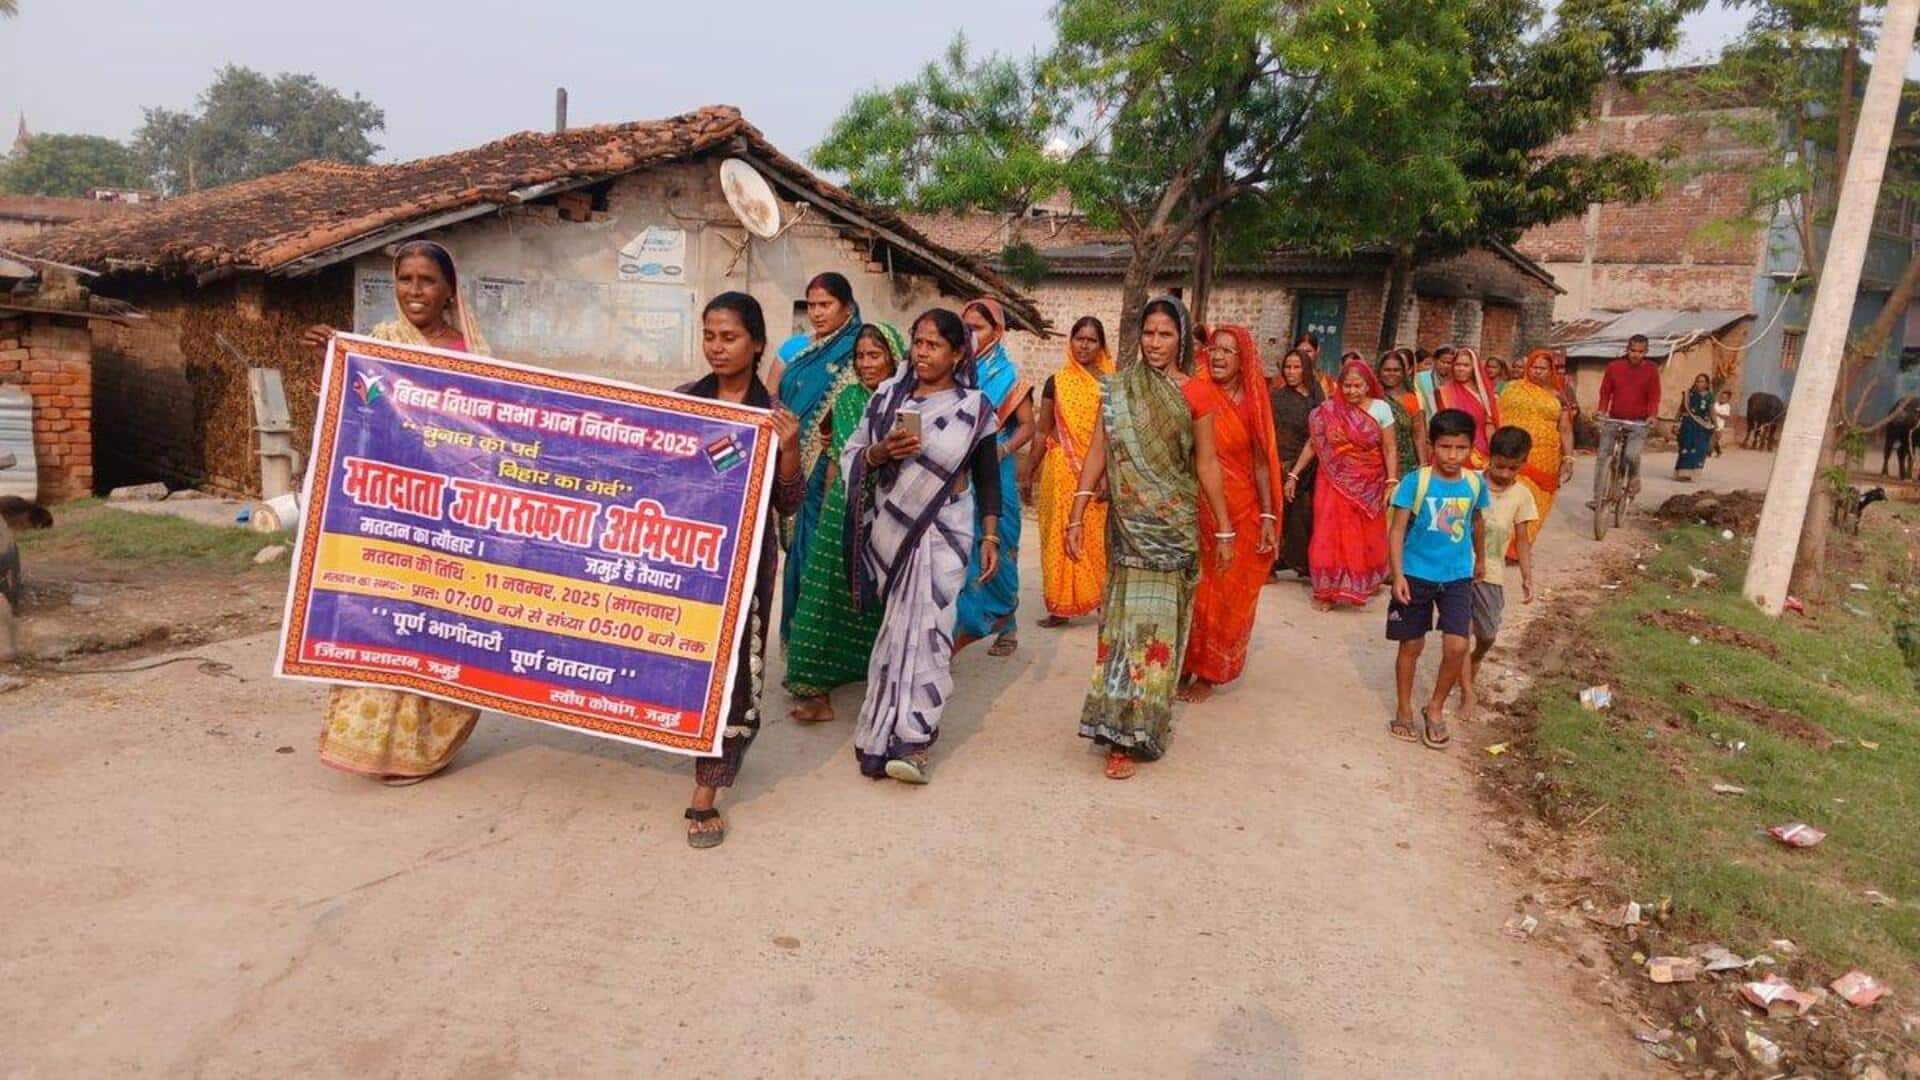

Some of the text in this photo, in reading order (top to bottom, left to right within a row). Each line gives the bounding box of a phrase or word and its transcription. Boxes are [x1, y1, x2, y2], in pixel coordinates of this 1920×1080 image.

[391, 377, 440, 409] बिहार
[442, 388, 493, 419] विधान
[497, 402, 537, 427] सभा
[539, 411, 577, 434] आम
[423, 426, 473, 448] चुनाव
[479, 436, 505, 454] का
[512, 440, 541, 459] पर्व
[498, 460, 550, 486] बिहार
[555, 474, 580, 491] का
[343, 457, 447, 520] मतदाता
[601, 498, 726, 571] अभियान
[360, 517, 410, 541] मतदान
[413, 528, 429, 545] का
[362, 547, 413, 570] मतदान
[435, 560, 465, 582] तिथि
[485, 573, 498, 589] 11
[563, 587, 600, 608] 2025
[605, 592, 682, 625] (मंगलवार)
[584, 557, 623, 583] जमुई
[624, 562, 636, 582] है
[392, 611, 425, 636] पूर्ण
[428, 620, 504, 652] भागीदारी
[444, 588, 493, 613] 07:00
[497, 602, 524, 619] बजे
[527, 607, 543, 624] से
[588, 617, 644, 642] 05:00
[648, 632, 676, 649] बजे
[679, 639, 708, 655] तक
[313, 641, 356, 661] जिला
[510, 648, 544, 674] पूर्ण
[546, 655, 616, 685] मतदान
[644, 709, 681, 728] जमुई
